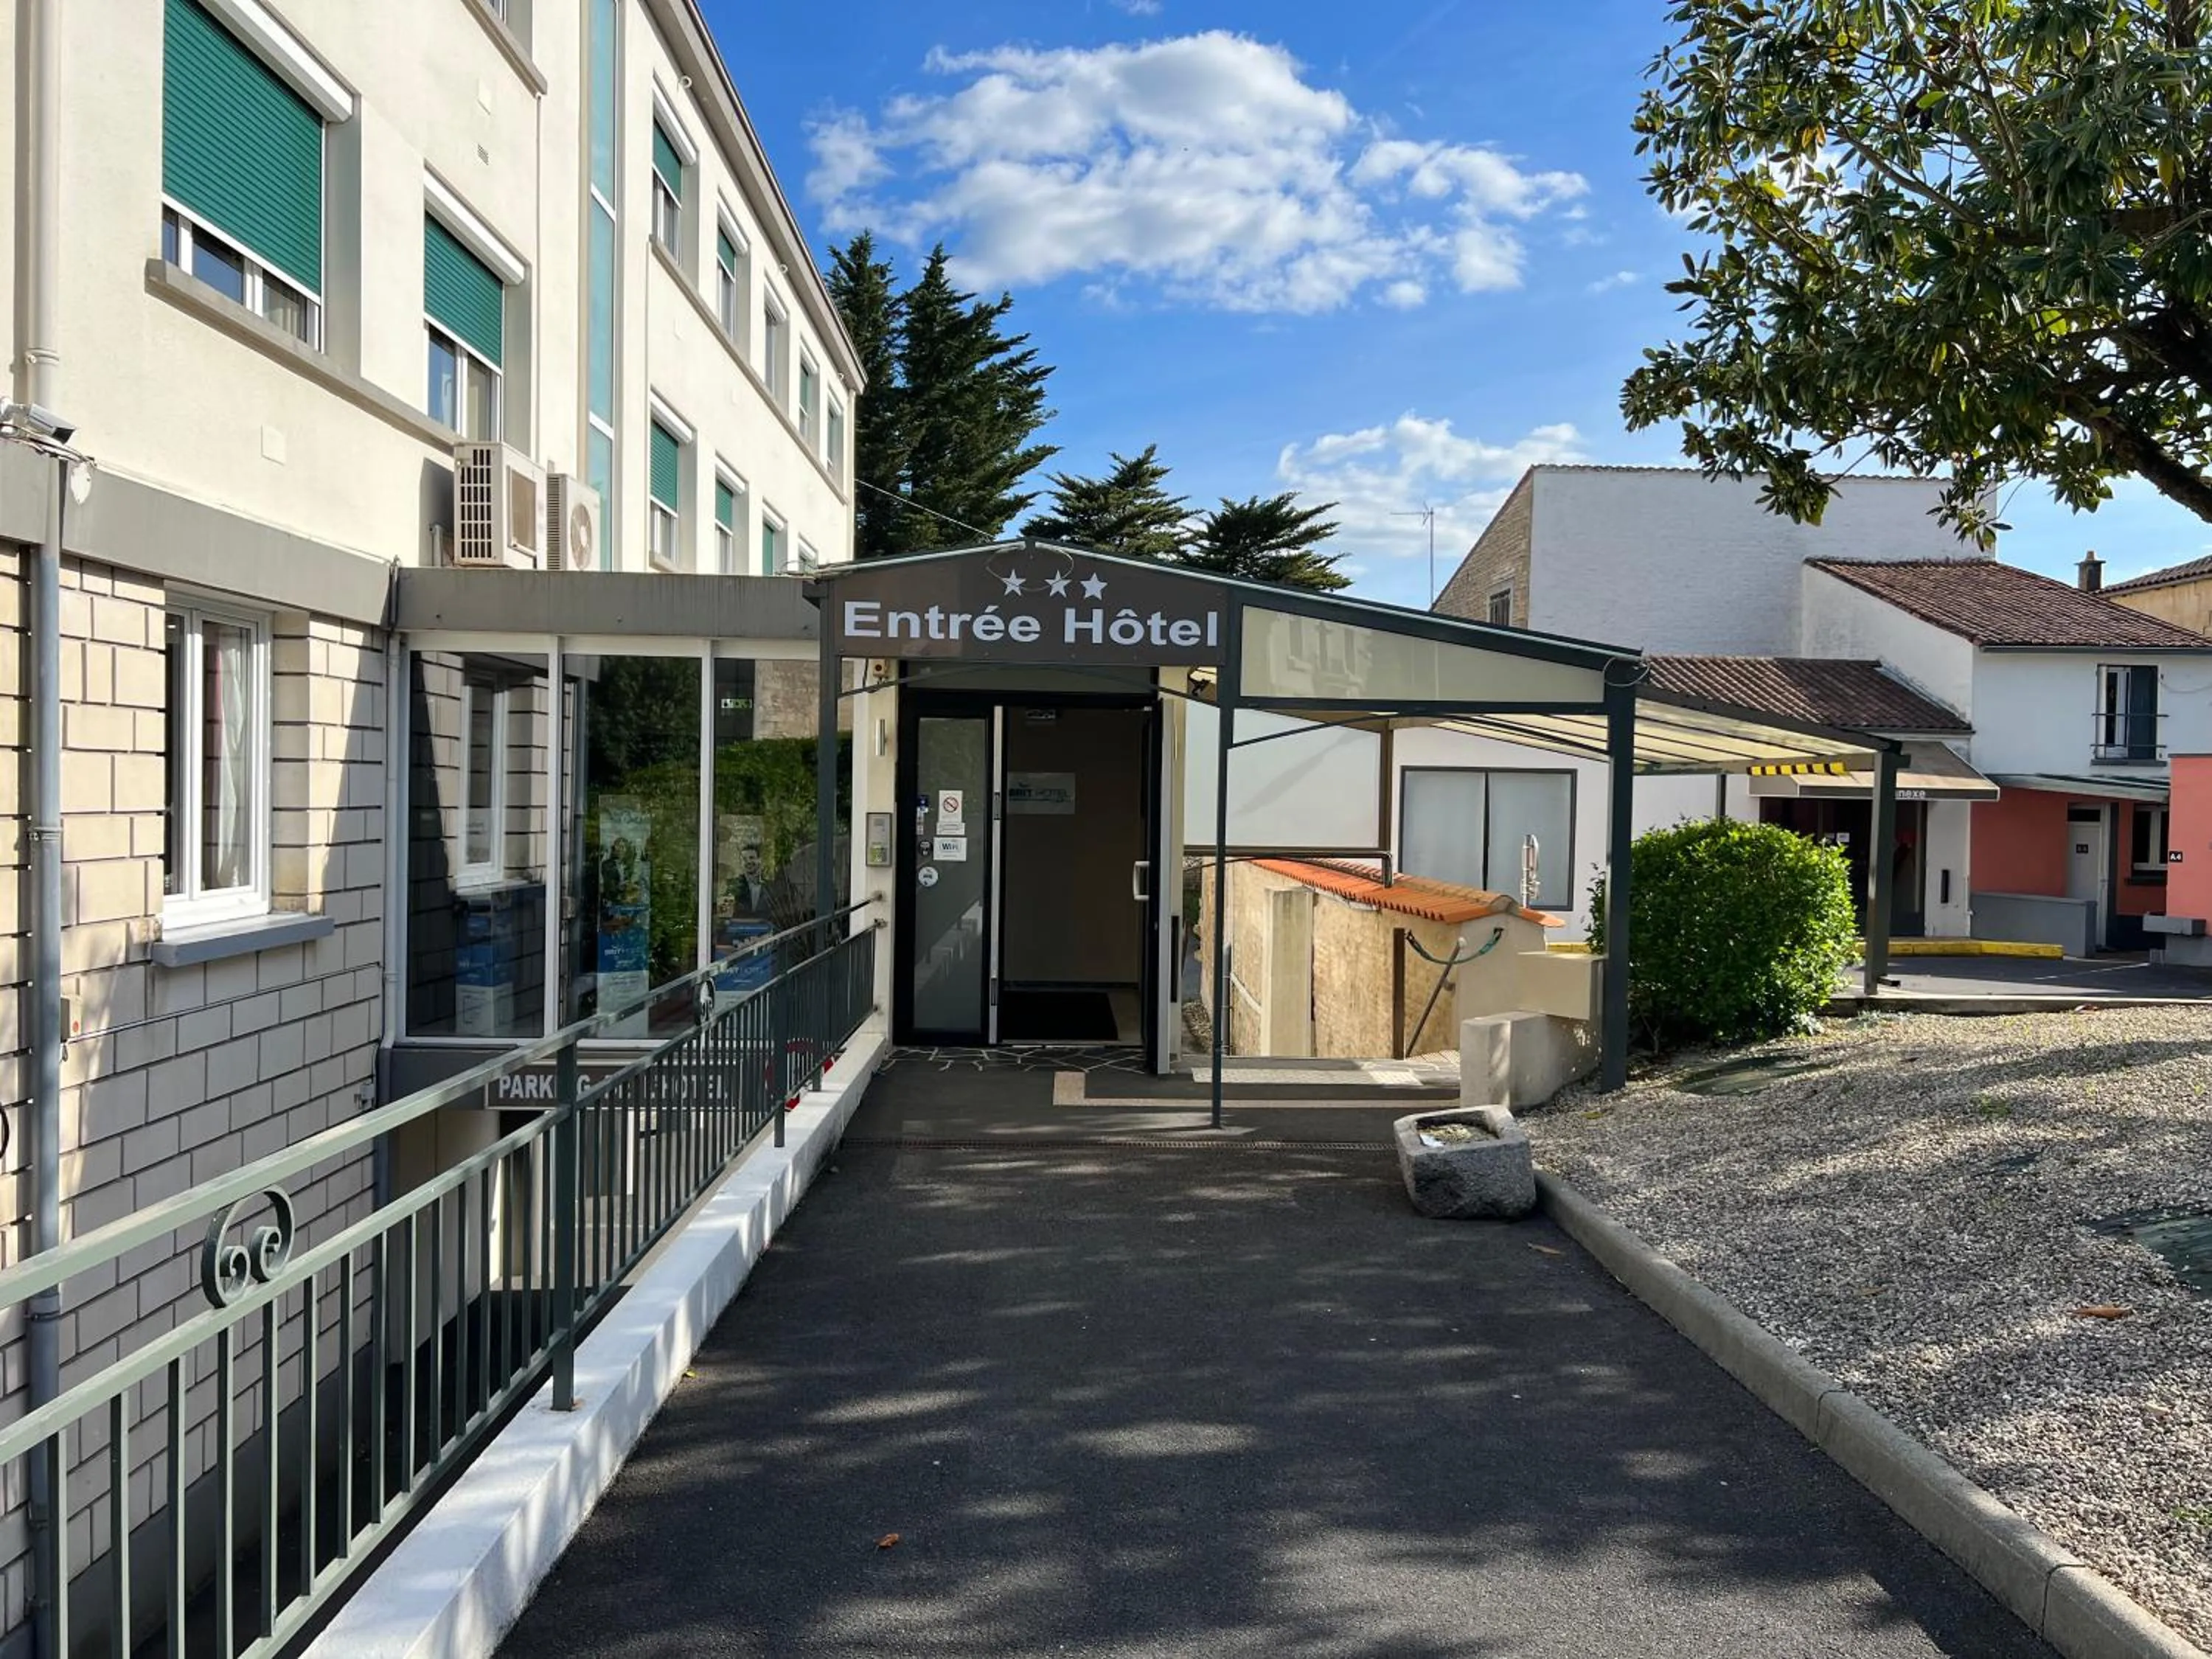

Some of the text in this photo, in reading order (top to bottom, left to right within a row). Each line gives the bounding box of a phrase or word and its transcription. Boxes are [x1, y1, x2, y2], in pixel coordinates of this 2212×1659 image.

[844, 601, 1217, 646] Entrée Hôtel
[498, 1074, 591, 1099] PARKG
